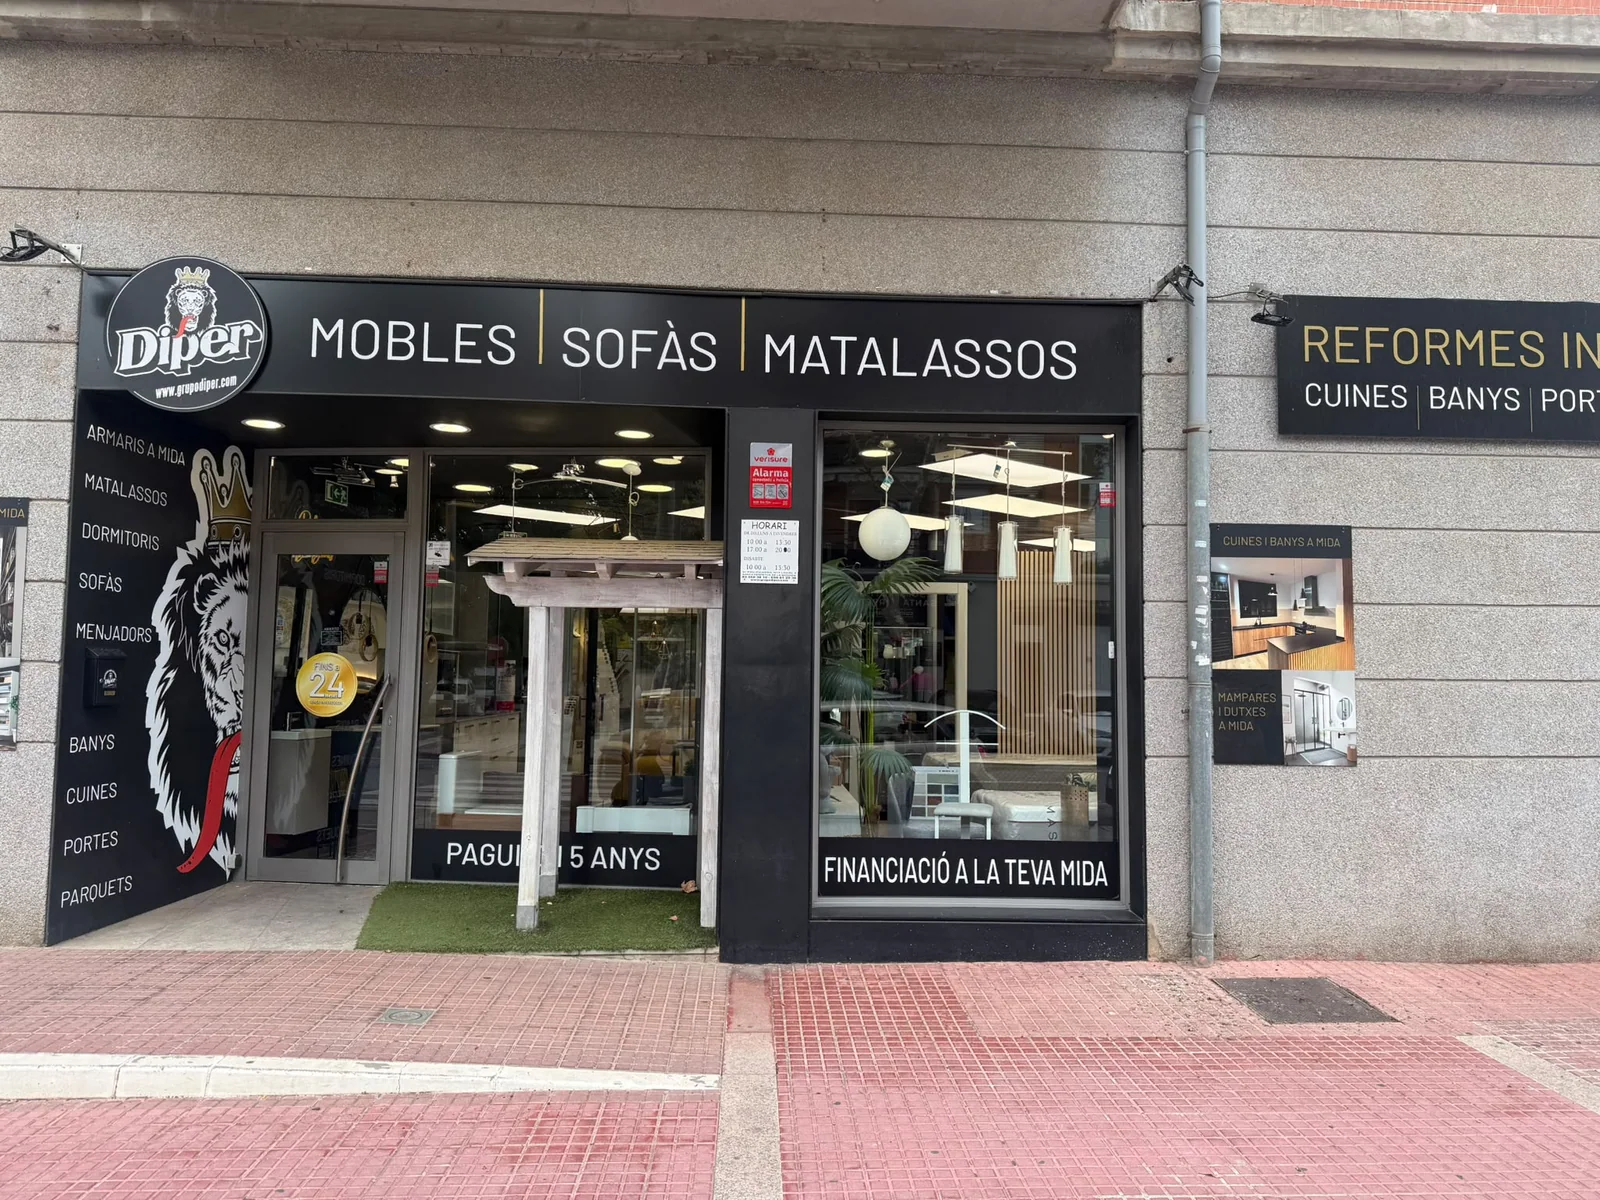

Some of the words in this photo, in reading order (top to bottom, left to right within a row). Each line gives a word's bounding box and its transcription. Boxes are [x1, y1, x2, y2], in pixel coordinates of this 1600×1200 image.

[118, 323, 255, 371] Diper
[311, 318, 516, 365] MOBLES
[562, 320, 717, 372] SOFÀS
[764, 334, 1077, 380] MATALASSOS
[1304, 325, 1545, 368] REFORMES
[155, 375, 238, 399] www.grupodiper.com
[1305, 383, 1408, 408] CUINES
[1429, 385, 1521, 411] BANYS
[86, 424, 146, 455] ARMARIS
[147, 442, 156, 458] A
[157, 445, 186, 466] MIDA
[753, 468, 789, 477] Alarma
[84, 472, 168, 507] MATALASSOS
[81, 522, 160, 551] DORMITORIS
[751, 521, 787, 530] HORARI
[1223, 536, 1263, 547] CUINES
[1270, 537, 1305, 547] BANYS
[1306, 537, 1314, 547] A
[1316, 538, 1341, 548] MIDA
[78, 572, 123, 593] SOFÀS
[76, 622, 152, 643] MENJADORS
[310, 671, 344, 699] 24
[1218, 692, 1277, 703] MAMPARES
[1224, 706, 1266, 717] DUTXES
[1218, 720, 1226, 730] A
[1228, 720, 1254, 731] MIDA
[69, 733, 116, 754] BANYS
[66, 782, 118, 805] CUINES
[64, 830, 119, 856] PORTES
[570, 845, 584, 869] 5
[590, 846, 661, 871] ANYS
[824, 850, 950, 884] FINANCIACIÓ
[954, 858, 969, 884] A
[973, 858, 1000, 885] LA
[1004, 858, 1056, 886] TEVA
[1060, 860, 1108, 887] MIDA
[60, 875, 133, 909] PARQUETS
